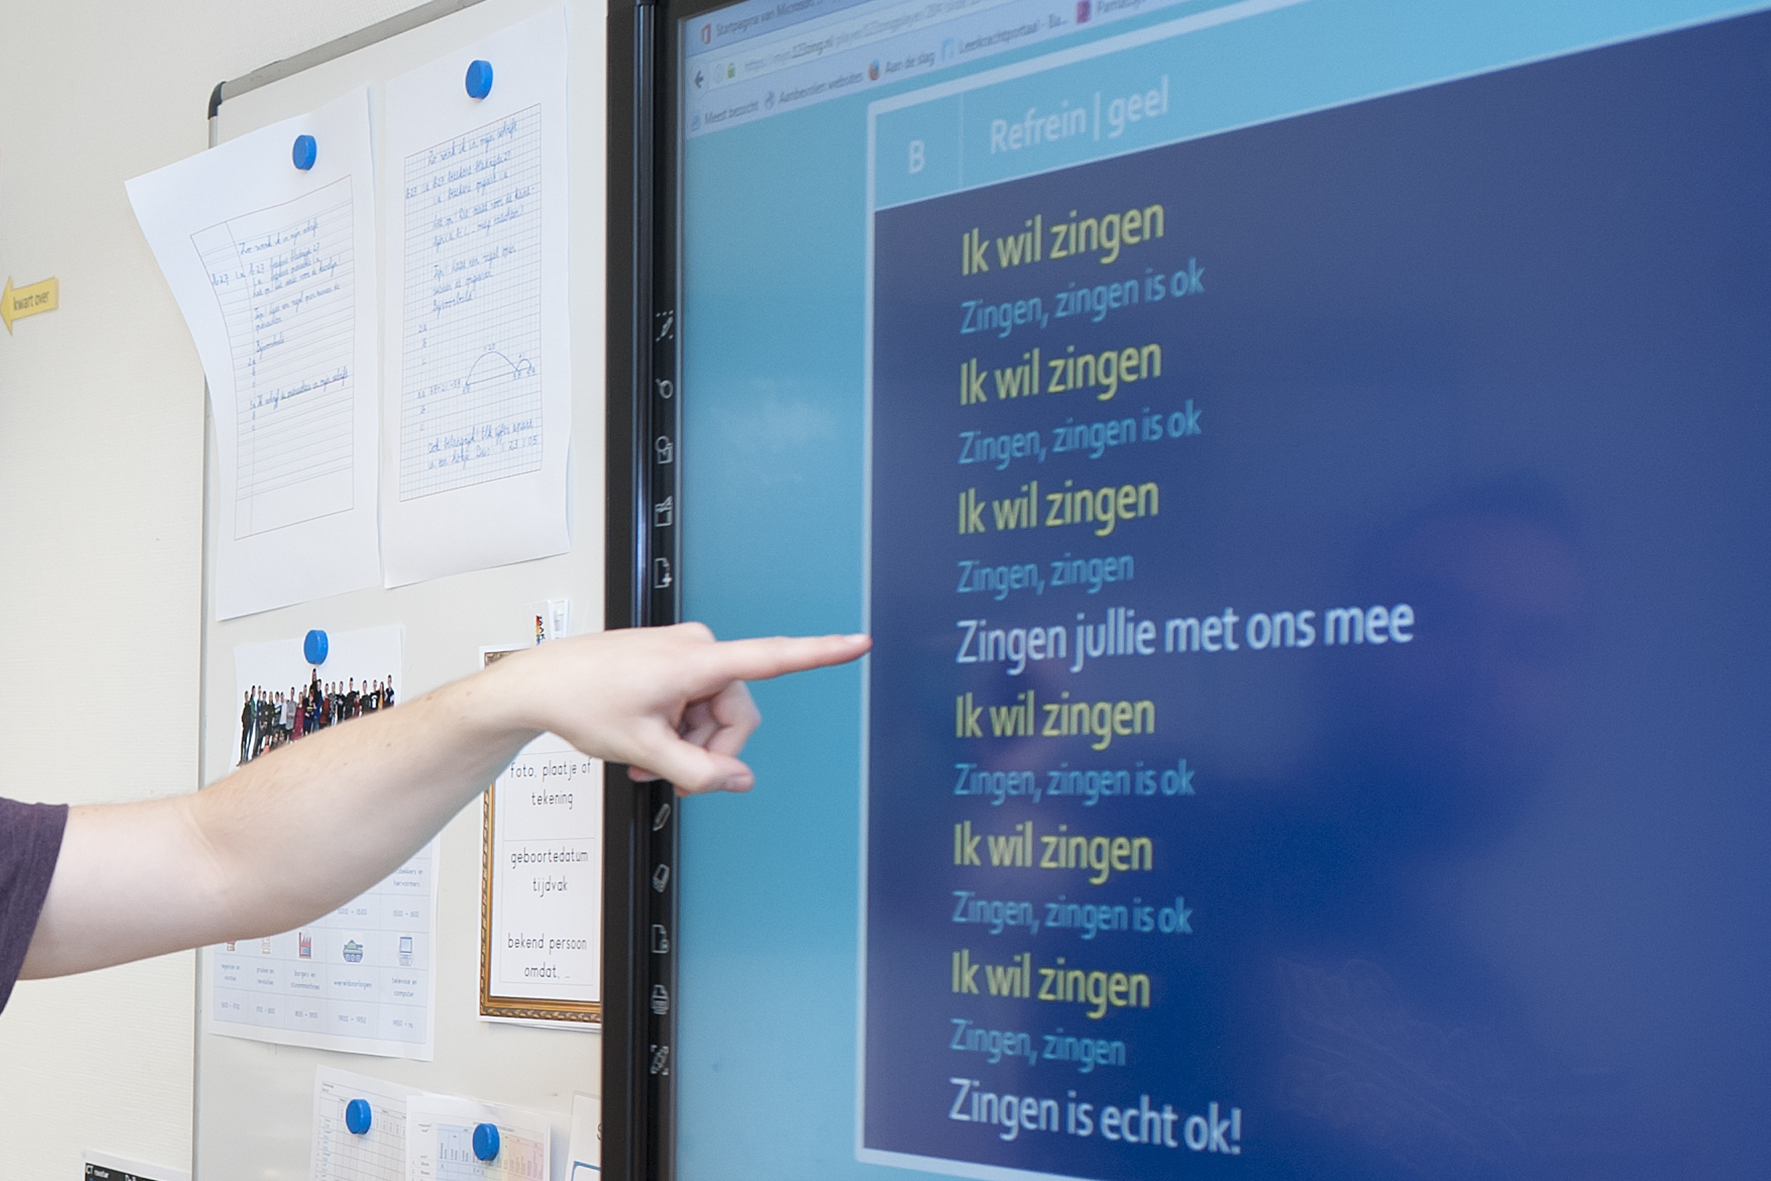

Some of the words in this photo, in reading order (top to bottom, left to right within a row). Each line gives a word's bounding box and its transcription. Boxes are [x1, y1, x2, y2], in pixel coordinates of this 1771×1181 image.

[989, 98, 1088, 156] Refrein
[1108, 74, 1170, 138] geel
[909, 138, 927, 175] B
[961, 227, 990, 276] Ik
[996, 214, 1042, 269] wil
[1049, 203, 1165, 265] zingen
[960, 292, 1049, 339] Zingen,
[1055, 276, 1140, 323] zingen
[1144, 268, 1167, 302] is
[1170, 257, 1206, 297] ok
[960, 357, 988, 406] Ik
[994, 348, 1040, 400] wil
[1047, 341, 1163, 401] zingen
[958, 428, 1047, 470] Zingen,
[1052, 416, 1137, 459] zingen
[1141, 407, 1165, 443] is
[1167, 398, 1203, 438] ok
[958, 488, 986, 534] Ik
[993, 480, 1039, 532] wil
[1045, 479, 1160, 537] zingen
[956, 558, 1045, 602] Zingen,
[1050, 552, 1135, 594] zingen
[955, 619, 1067, 676] Zingen
[1070, 606, 1158, 674] jullie
[1164, 607, 1240, 653] met
[1245, 608, 1317, 651] ons
[1325, 603, 1416, 645] mee
[955, 693, 983, 739] Ik
[990, 690, 1035, 737] wil
[1042, 691, 1156, 751] zingen
[542, 758, 578, 782] plaatje
[581, 757, 593, 774] of
[953, 762, 1042, 805] Zingen,
[1046, 762, 1131, 806] zingen
[1134, 761, 1158, 796] is
[1161, 758, 1197, 798] ok
[531, 789, 574, 810] tekening
[510, 846, 589, 870] geboortedatum
[953, 820, 981, 867] Ik
[988, 820, 1033, 868] wil
[1039, 823, 1153, 886] zingen
[532, 875, 569, 898] tijdvak
[952, 889, 1040, 935] Zingen,
[1044, 894, 1128, 940] zingen
[1132, 896, 1156, 932] is
[1157, 895, 1193, 935] ok
[507, 932, 545, 950] bekend
[548, 935, 588, 956] persoon
[951, 948, 979, 994] Ik
[985, 951, 1031, 998] wil
[1037, 957, 1152, 1021] zingen
[949, 1018, 1038, 1064] Zingen,
[1042, 1027, 1127, 1074] zingen
[948, 1077, 1060, 1142] Zingen
[1066, 1088, 1095, 1137] is
[1099, 1094, 1179, 1149] echt
[1183, 1100, 1244, 1156] ok!
